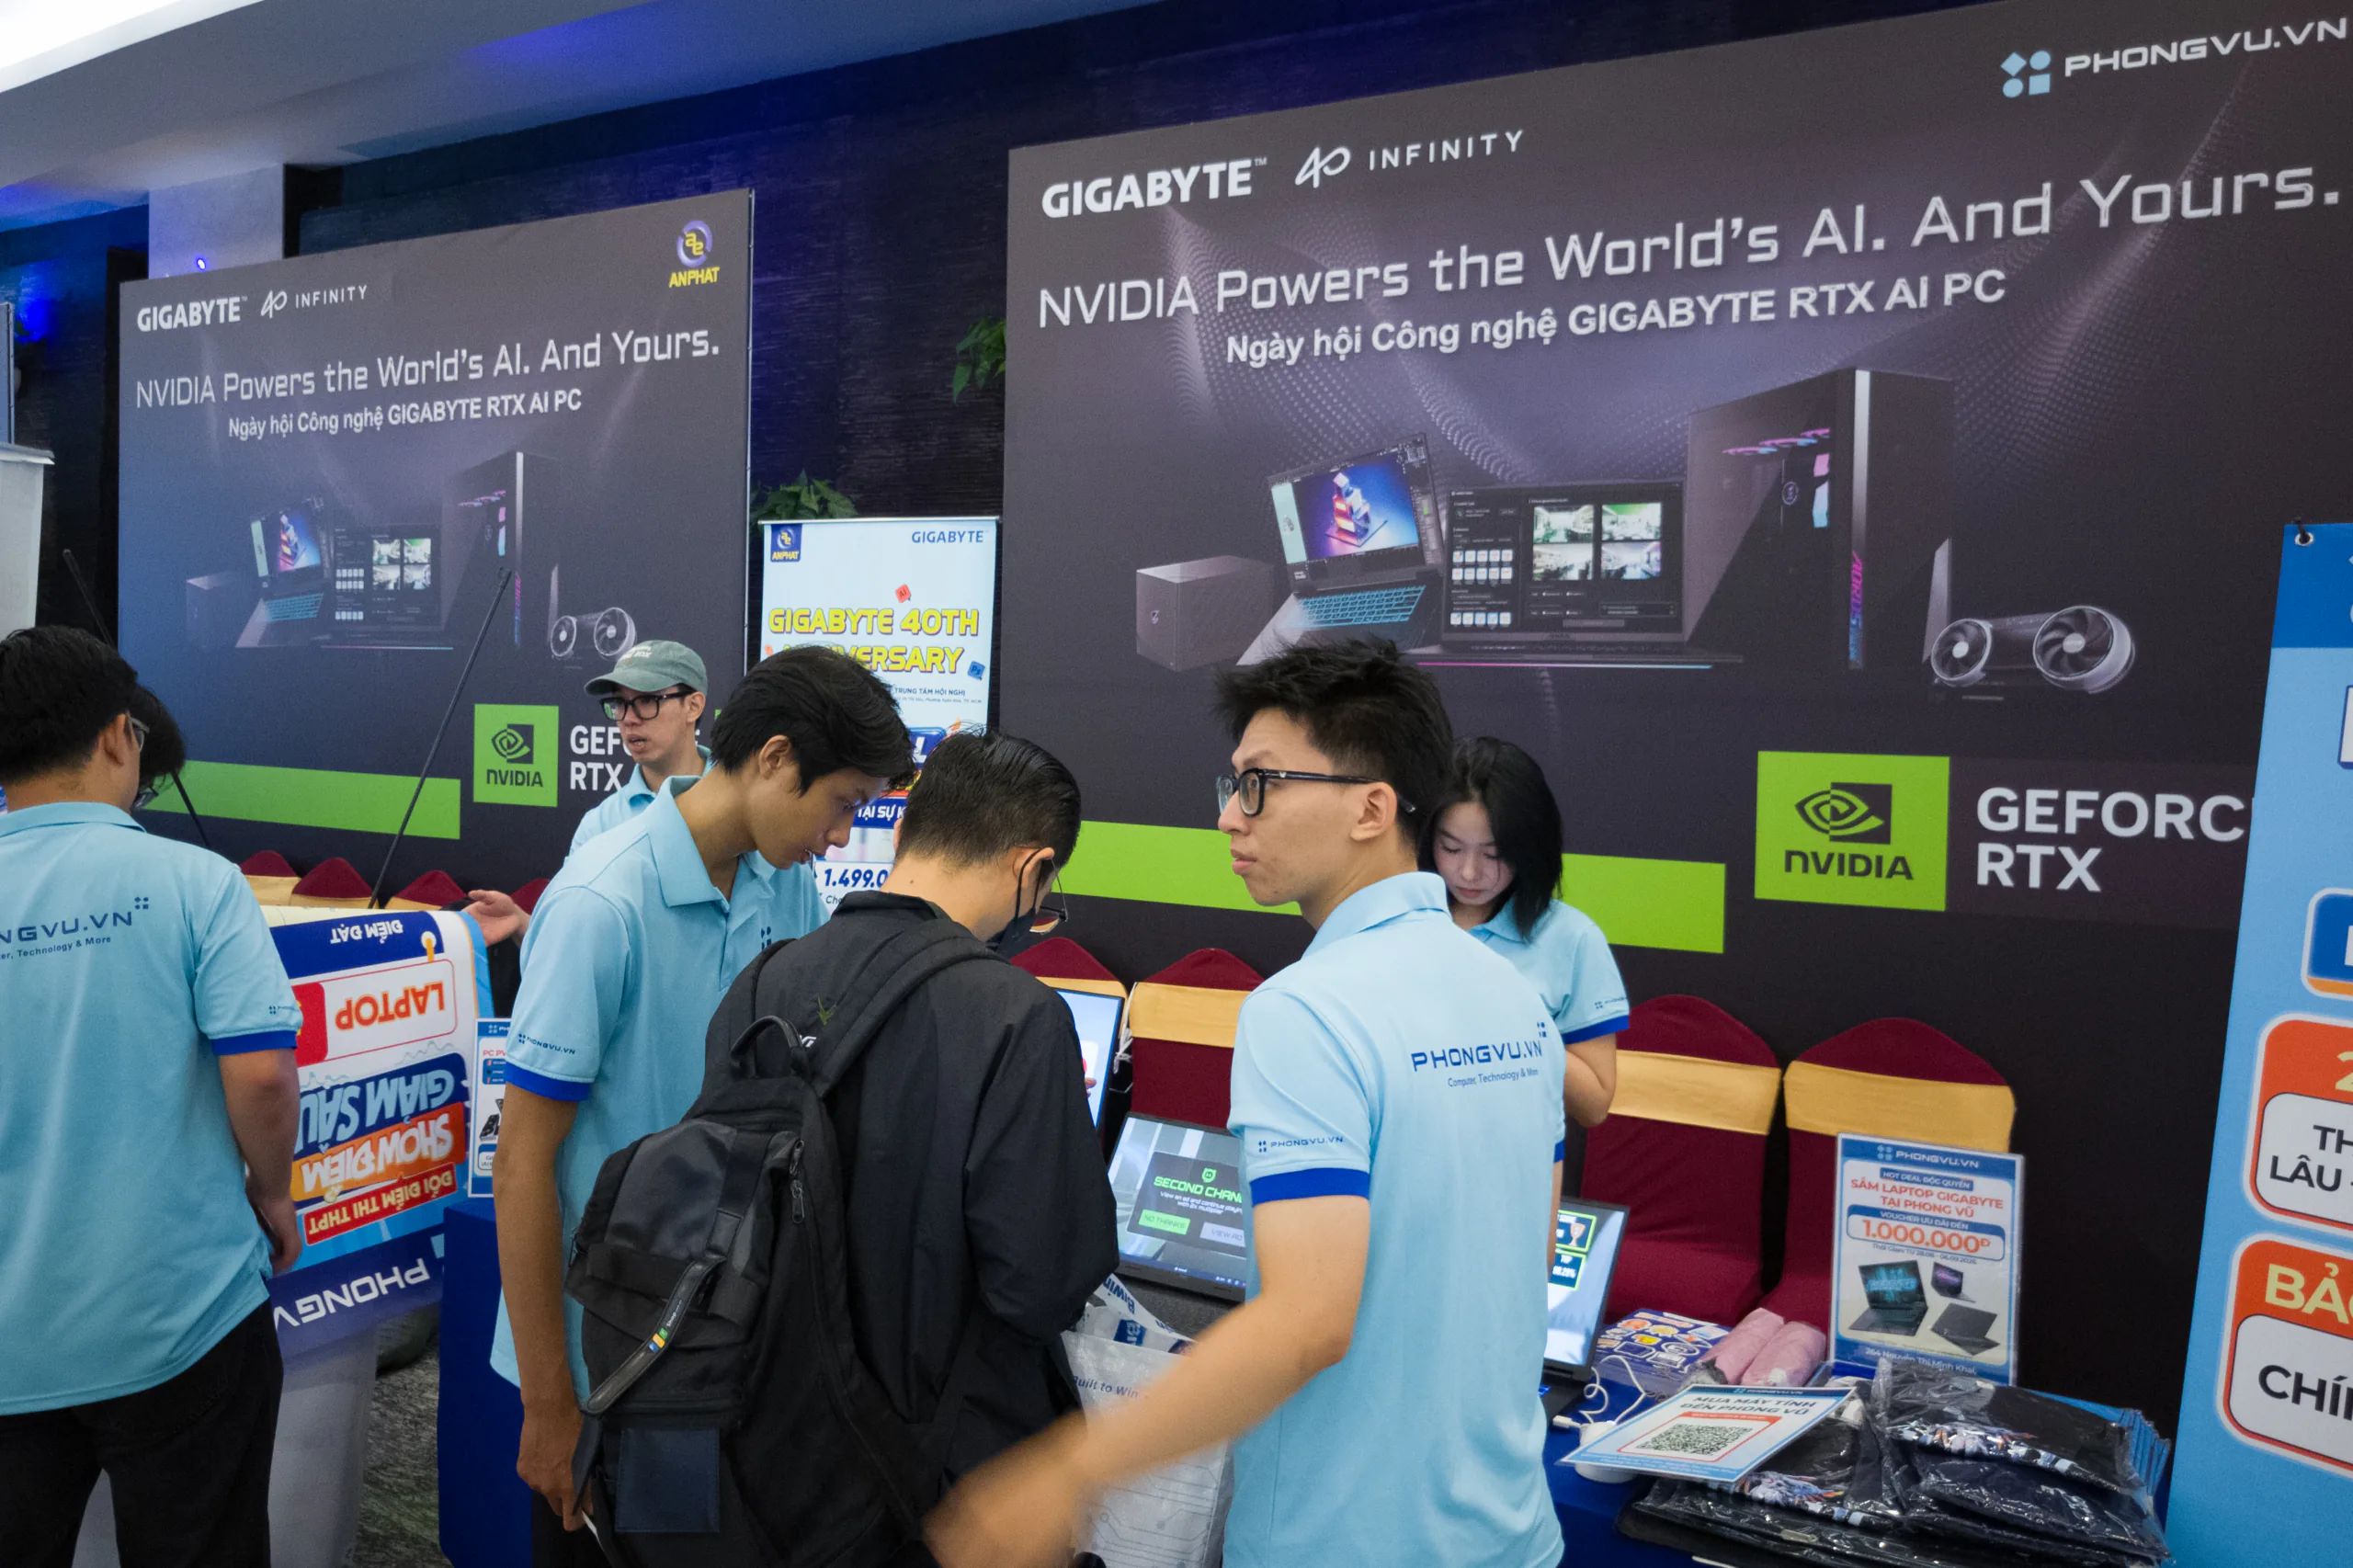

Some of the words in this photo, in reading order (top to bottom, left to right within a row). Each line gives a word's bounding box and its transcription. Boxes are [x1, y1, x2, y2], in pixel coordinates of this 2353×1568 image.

[2063, 17, 2347, 77] PHONGVU.VN
[1369, 130, 1524, 172] INFINITY
[1039, 276, 1199, 328] NVIDIA
[1216, 261, 1409, 313] Powers
[1428, 244, 1524, 292] the
[1544, 216, 1779, 280] World's
[1802, 203, 1885, 257] AI.
[1910, 181, 2052, 247] And
[2079, 166, 2339, 229] Yours.
[668, 266, 721, 289] ANPHAT
[137, 296, 241, 332] GIGABYTE
[295, 284, 368, 309] INFINITY
[1227, 330, 1304, 369] Ngày
[1313, 324, 1362, 361] hội
[1370, 320, 1460, 354] Công
[1470, 308, 1558, 346] nghệ
[1567, 289, 1777, 336] GIGABYTE
[1788, 280, 1876, 319] RTX
[1883, 276, 1928, 312] AI
[1942, 269, 2006, 307] PC
[136, 375, 217, 409] NVIDIA
[223, 371, 316, 402] Powers
[324, 360, 369, 392] the
[377, 348, 483, 388] World's
[493, 342, 530, 377] AI.
[540, 332, 601, 373] And
[611, 329, 720, 366] Yours.
[228, 416, 267, 441] Ngày
[270, 413, 294, 438] hội
[297, 411, 339, 436] Công
[343, 405, 384, 432] nghệ
[387, 397, 483, 426] GIGABYTE
[486, 392, 526, 418] RTX
[529, 390, 550, 415] AI
[554, 388, 583, 412] PC
[911, 529, 984, 544] GIGABYTE
[771, 551, 799, 561] ANPHAT
[768, 608, 894, 634] GIGABYTE
[899, 608, 980, 636] 40TH
[570, 761, 624, 791] RTX
[1976, 787, 2255, 842] GEFORC
[1976, 842, 2102, 892] RTX
[330, 923, 363, 944] ĐẠT
[363, 919, 404, 944] ĐIỂM
[17, 941, 74, 958] Technology
[75, 938, 83, 948] &
[85, 936, 112, 947] More
[335, 980, 446, 1031] LAPTOP
[1410, 1040, 1544, 1073] PHONGVU.VN
[365, 1069, 456, 1125] GIẢM
[377, 1112, 454, 1175] SHOW
[1269, 1135, 1345, 1149] PHONGVU.VN
[1895, 1150, 1980, 1168] PHONGVU.VN
[2269, 1154, 2343, 1192] LÂU
[1154, 1176, 1205, 1196] SECOND
[1881, 1181, 1934, 1199] LAPTOP
[1936, 1190, 2005, 1210] GIGABYTE
[308, 1206, 351, 1235] THPT
[352, 1194, 381, 1220] THI
[1879, 1210, 1920, 1223] VOUCHER
[1904, 1199, 1952, 1216] PHONG
[2265, 1262, 2353, 1324] BẢ
[1100, 1381, 1112, 1393] to
[1717, 1403, 1780, 1414] PHONG
